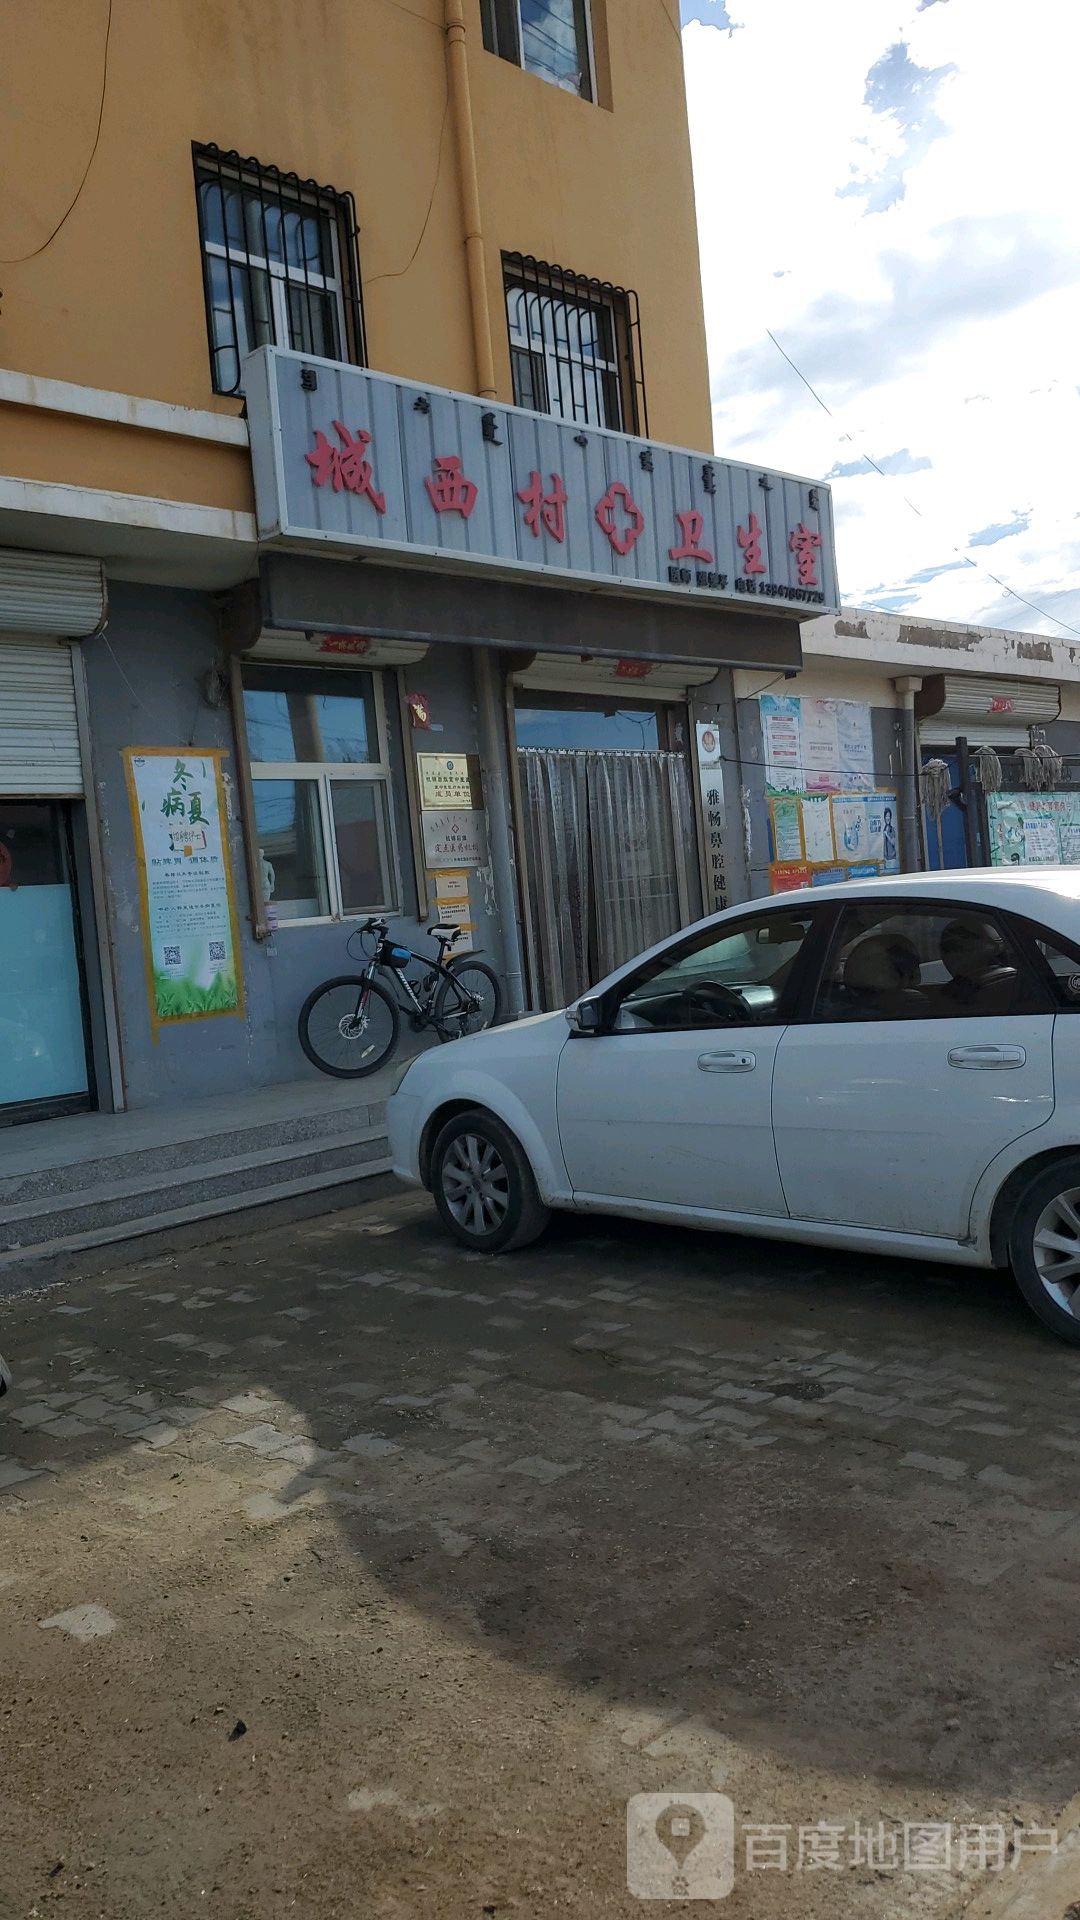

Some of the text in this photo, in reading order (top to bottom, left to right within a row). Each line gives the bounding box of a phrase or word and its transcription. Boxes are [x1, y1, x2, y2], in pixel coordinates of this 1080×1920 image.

[305, 419, 569, 544] 城西村
[668, 509, 823, 586] 卫生室
[172, 758, 194, 791] 冬
[706, 788, 727, 911] 雅畅鼻腔健康
